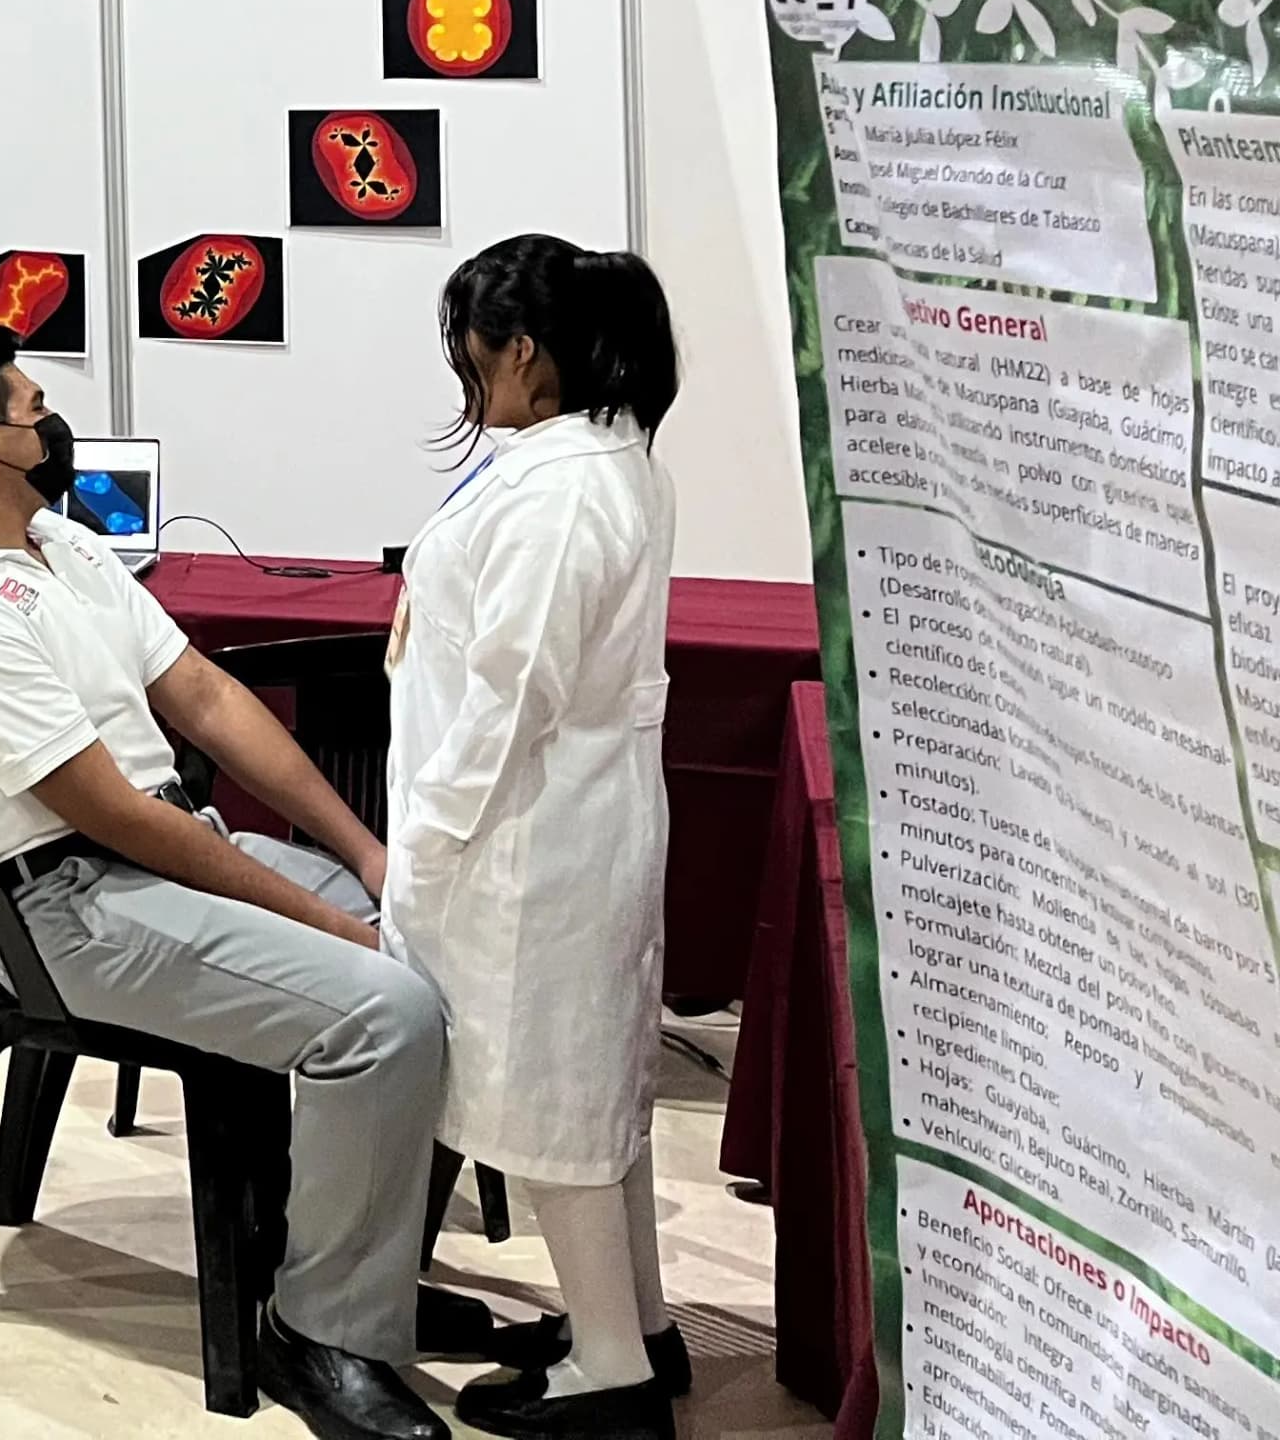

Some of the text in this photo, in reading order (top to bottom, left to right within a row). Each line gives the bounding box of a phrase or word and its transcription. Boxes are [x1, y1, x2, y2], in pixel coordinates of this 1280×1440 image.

[853, 81, 1111, 120] y Afiliación Institucional
[938, 125, 981, 151] López
[985, 129, 1019, 149] Félix
[896, 162, 1067, 190] Miguel Ovando de la Cruz
[1189, 185, 1232, 210] En las
[921, 199, 940, 218] de
[1019, 209, 1040, 228] de
[1042, 209, 1101, 233] Tabasco
[931, 242, 966, 262] de la
[834, 314, 881, 333] Crear
[956, 306, 1048, 343] General
[1247, 313, 1274, 333] una
[1205, 338, 1256, 363] pero se
[990, 356, 1051, 386] (HM22)
[1060, 371, 1069, 387] a
[1079, 373, 1112, 397] base
[1122, 382, 1141, 404] de
[1150, 386, 1190, 417] hojas
[1208, 376, 1257, 407] integre
[840, 374, 1188, 453] Hierba Macuspana (Guayaba, Guácimo,
[845, 408, 1187, 489] para instrumentos domésticos
[846, 437, 1097, 493] acelere la polvo con
[1208, 448, 1267, 485] impacto
[849, 467, 1200, 561] accesible superficiales de manera
[877, 545, 942, 574] Tipo de
[879, 576, 971, 612] (Desarrollo
[1228, 612, 1273, 643] eficaz
[883, 606, 1157, 737] El proceso un modelo
[886, 639, 986, 677] científico de
[888, 667, 993, 707] Recolección:
[891, 699, 1007, 744] seleccionadas
[892, 727, 1001, 770] Preparación:
[895, 762, 981, 796] minutos).
[899, 787, 1030, 843] Tostado: Tueste
[900, 822, 1016, 868] minutos para
[900, 849, 1097, 935] Pulverización: Molienda
[901, 882, 1095, 963] molcajete hasta obtener
[904, 909, 1101, 1001] Formulación: Mezcla del
[908, 938, 1139, 1053] lograr una textura de pomada
[909, 970, 1120, 1073] Almacenamiento: Reposo
[912, 1001, 1049, 1071] recipiente limpio.
[915, 1027, 1060, 1108] Ingredientes Clave:
[920, 1058, 1195, 1215] Hojas: Guayaba, Guácimo, Hierba
[920, 1116, 996, 1164] Vehículo:
[1028, 1139, 1076, 1180] Bejuco
[917, 1209, 994, 1258] Beneficio
[922, 1267, 1009, 1329] Innovación:
[932, 1249, 1015, 1304] económica
[963, 1188, 1212, 1367] Aportaciones o Impacto
[923, 1298, 1014, 1364] metodología
